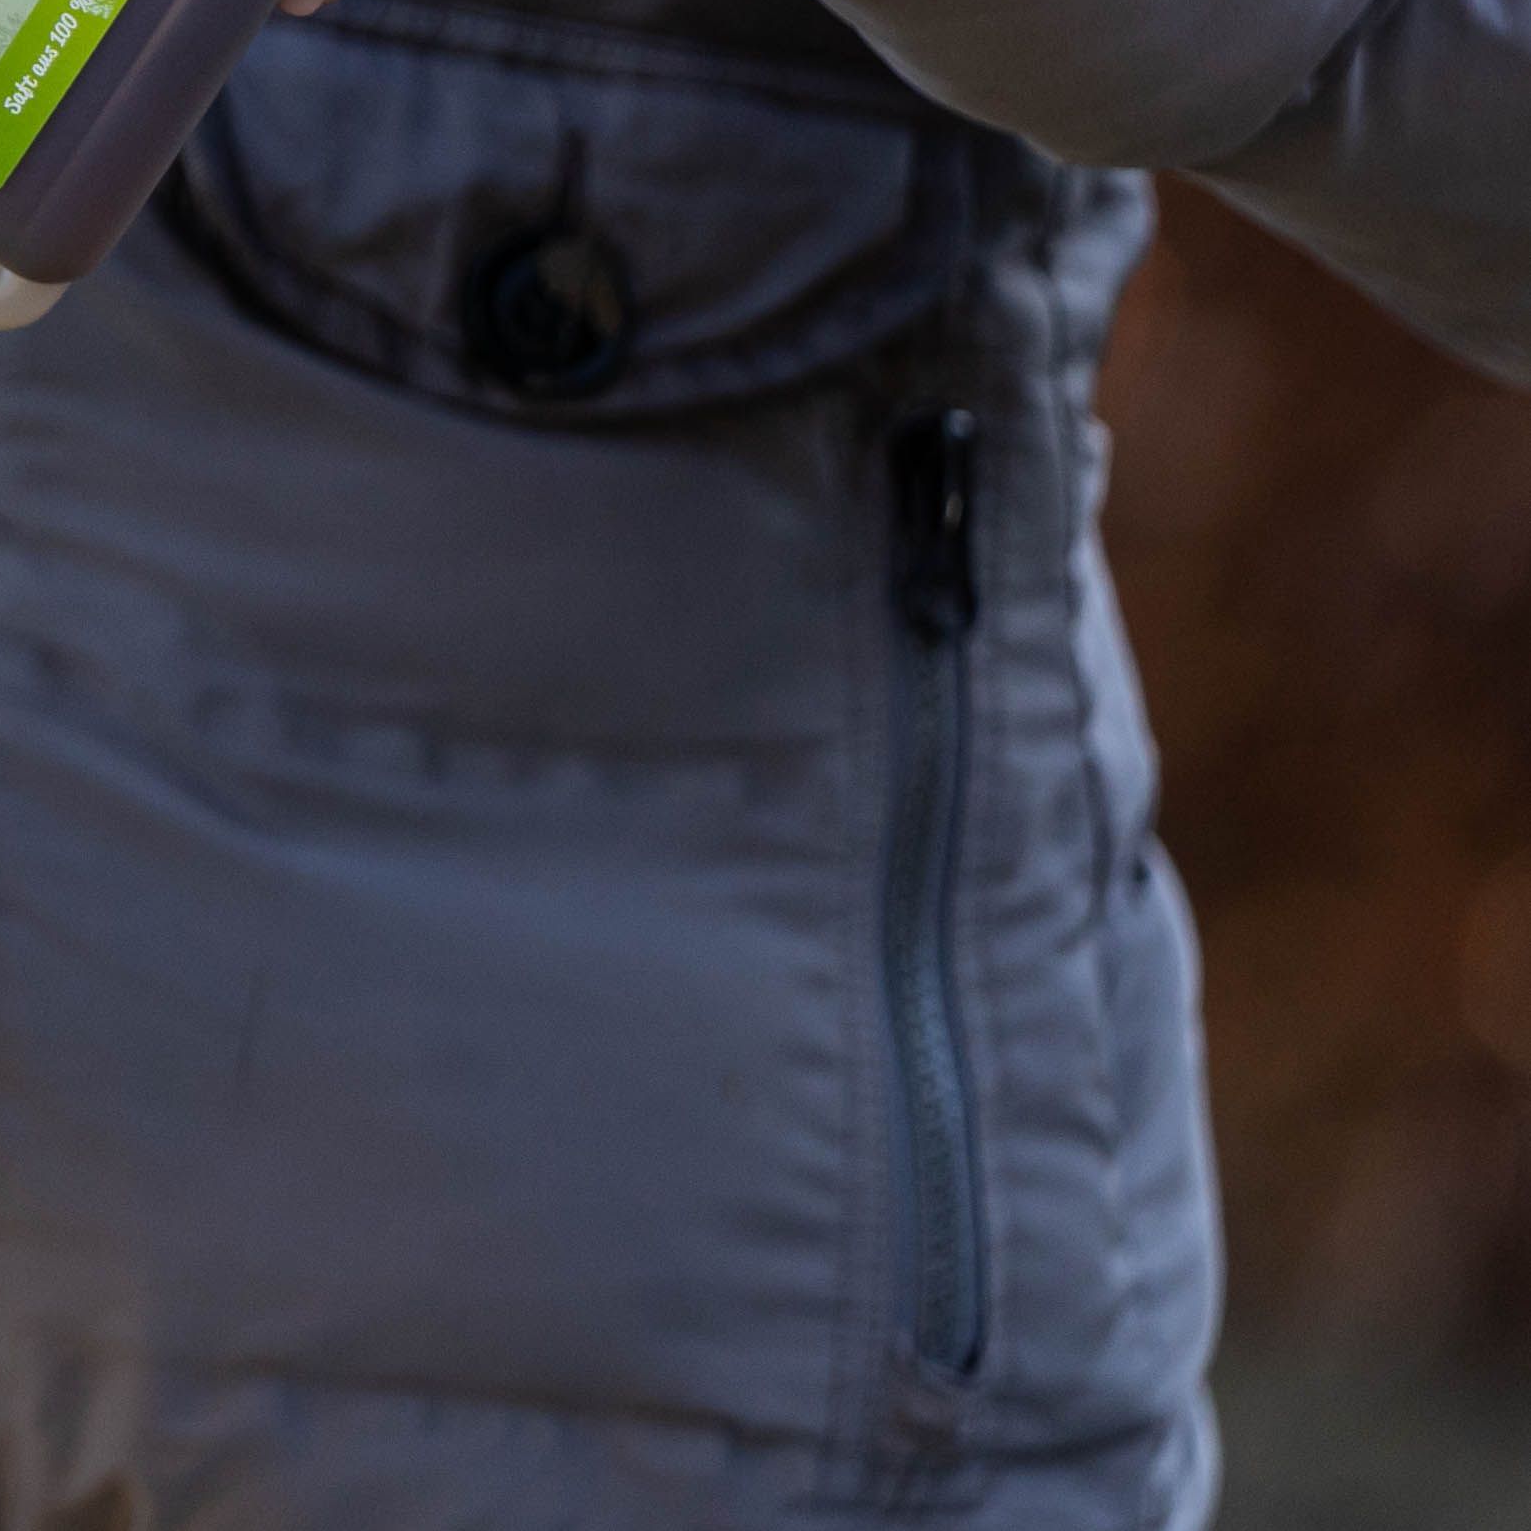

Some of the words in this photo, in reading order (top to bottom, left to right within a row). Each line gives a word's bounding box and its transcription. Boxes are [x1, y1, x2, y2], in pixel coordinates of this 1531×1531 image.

[4, 72, 38, 115] Saft
[32, 45, 59, 76] aus
[50, 12, 79, 48] 100
